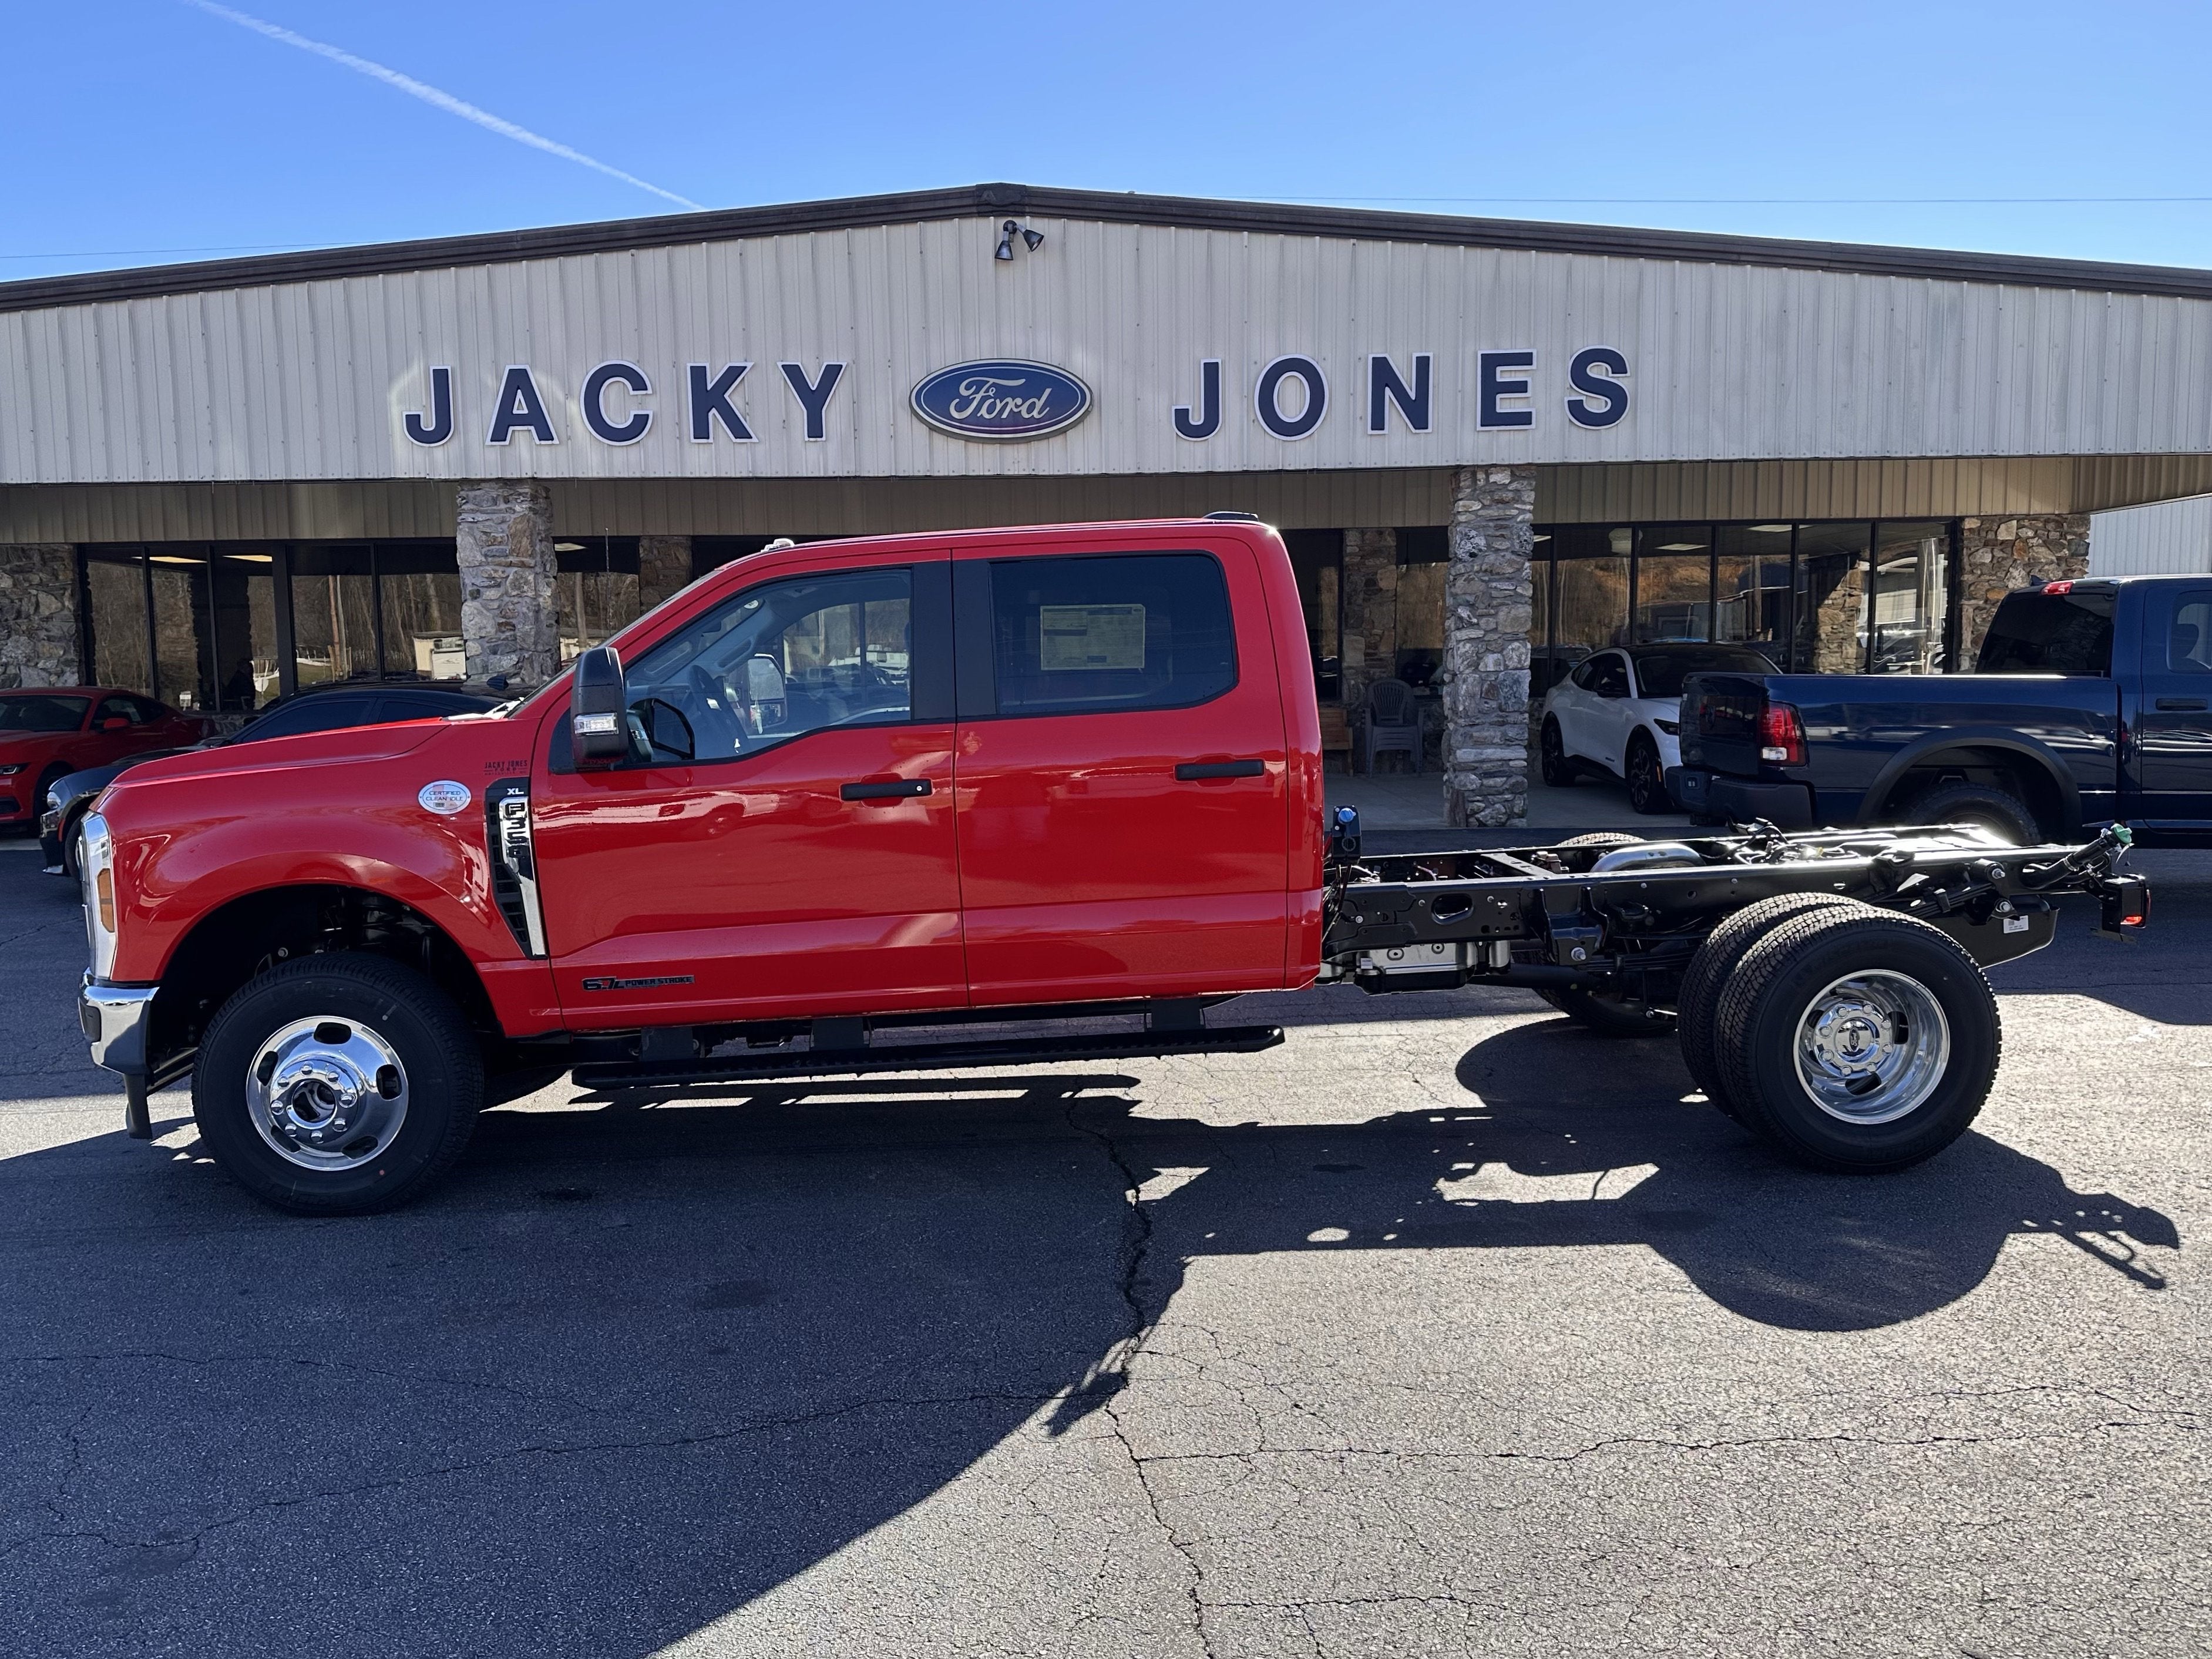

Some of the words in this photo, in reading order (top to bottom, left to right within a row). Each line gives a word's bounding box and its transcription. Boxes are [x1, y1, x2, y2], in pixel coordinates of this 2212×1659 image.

[403, 360, 847, 446] JACKY
[1172, 345, 1631, 441] JONES
[949, 377, 1052, 419] Ford
[658, 976, 692, 984] STROKE
